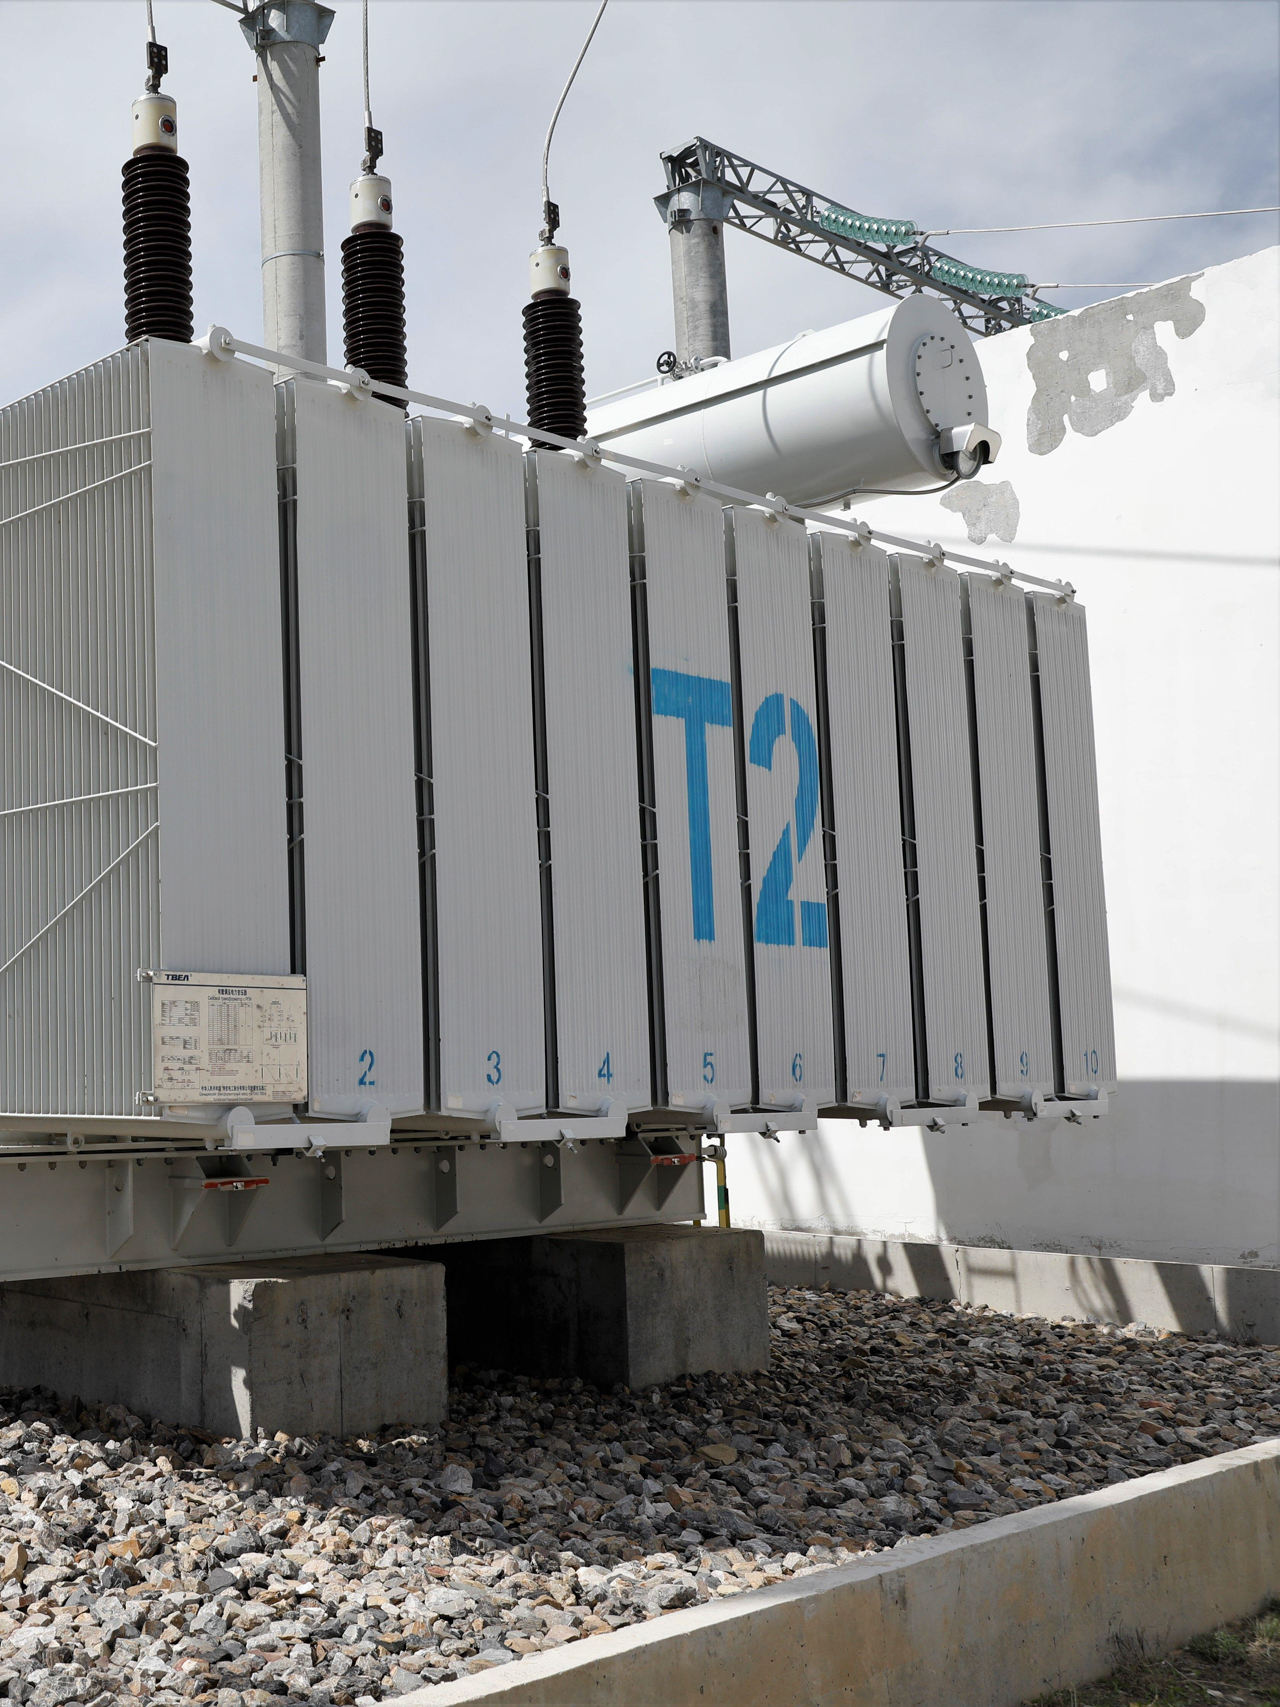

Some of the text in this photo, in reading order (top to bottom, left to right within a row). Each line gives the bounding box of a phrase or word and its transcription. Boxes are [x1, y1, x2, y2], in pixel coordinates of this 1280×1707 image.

[650, 667, 828, 949] T2
[357, 1049, 376, 1087] 2
[486, 1050, 503, 1086] 3
[597, 1051, 614, 1085] 4
[702, 1051, 716, 1084] 5
[791, 1053, 804, 1082] 6
[876, 1052, 887, 1081] 7
[954, 1052, 964, 1080] 8
[1020, 1050, 1029, 1077] 9
[1083, 1049, 1099, 1077] 10
